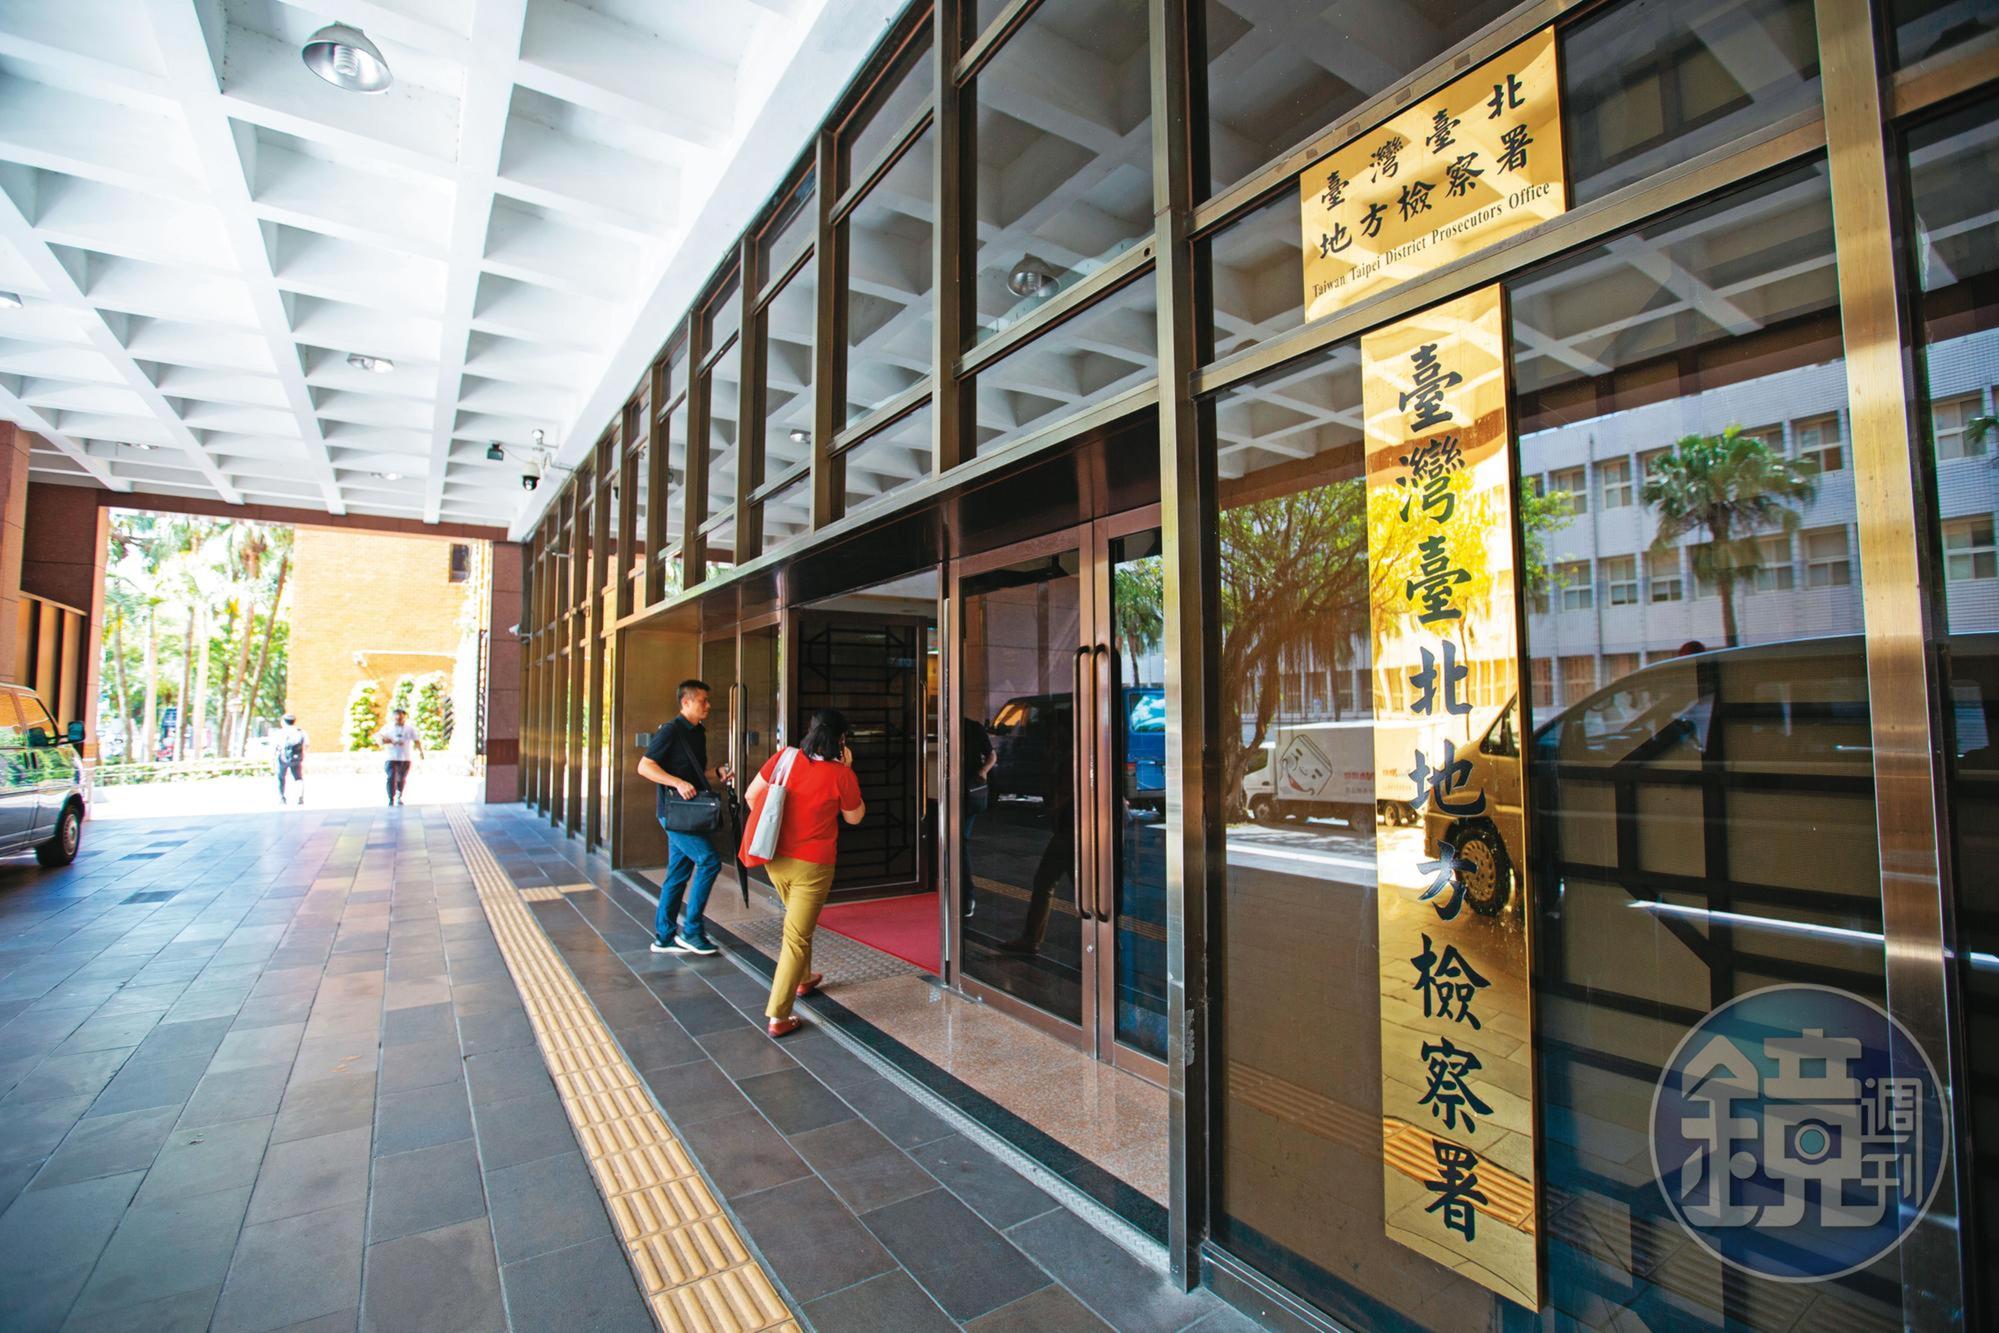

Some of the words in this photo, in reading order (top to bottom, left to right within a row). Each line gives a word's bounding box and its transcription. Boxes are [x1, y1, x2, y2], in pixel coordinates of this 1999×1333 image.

[1320, 124, 1534, 259] 地方檢察署
[1321, 74, 1526, 211] 臺灣臺北
[1312, 275, 1346, 298] Taiwan
[1350, 256, 1381, 281] Taipei
[1385, 237, 1427, 265] District
[1431, 204, 1503, 245] Prosecutors
[1508, 182, 1550, 210] Office
[1397, 342, 1493, 1243] 臺灣臺北地方檢察署
